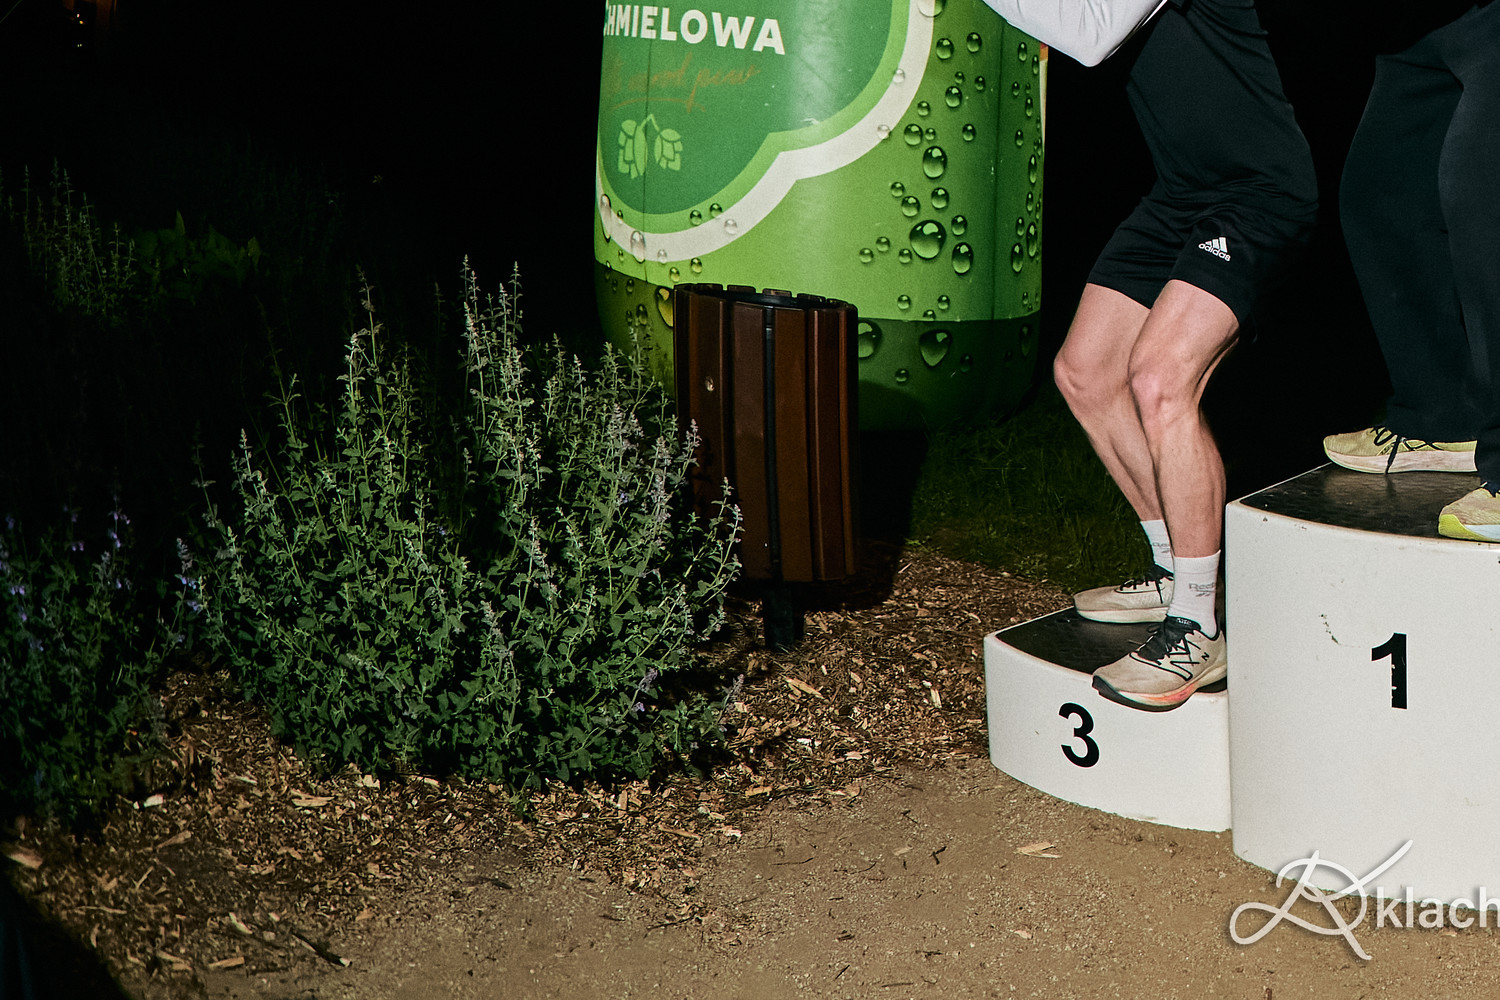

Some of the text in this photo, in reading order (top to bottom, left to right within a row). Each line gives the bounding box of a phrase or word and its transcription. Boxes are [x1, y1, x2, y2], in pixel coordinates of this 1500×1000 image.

[1198, 243, 1231, 262] adidas
[1371, 632, 1408, 710] 1
[1058, 702, 1100, 768] 3
